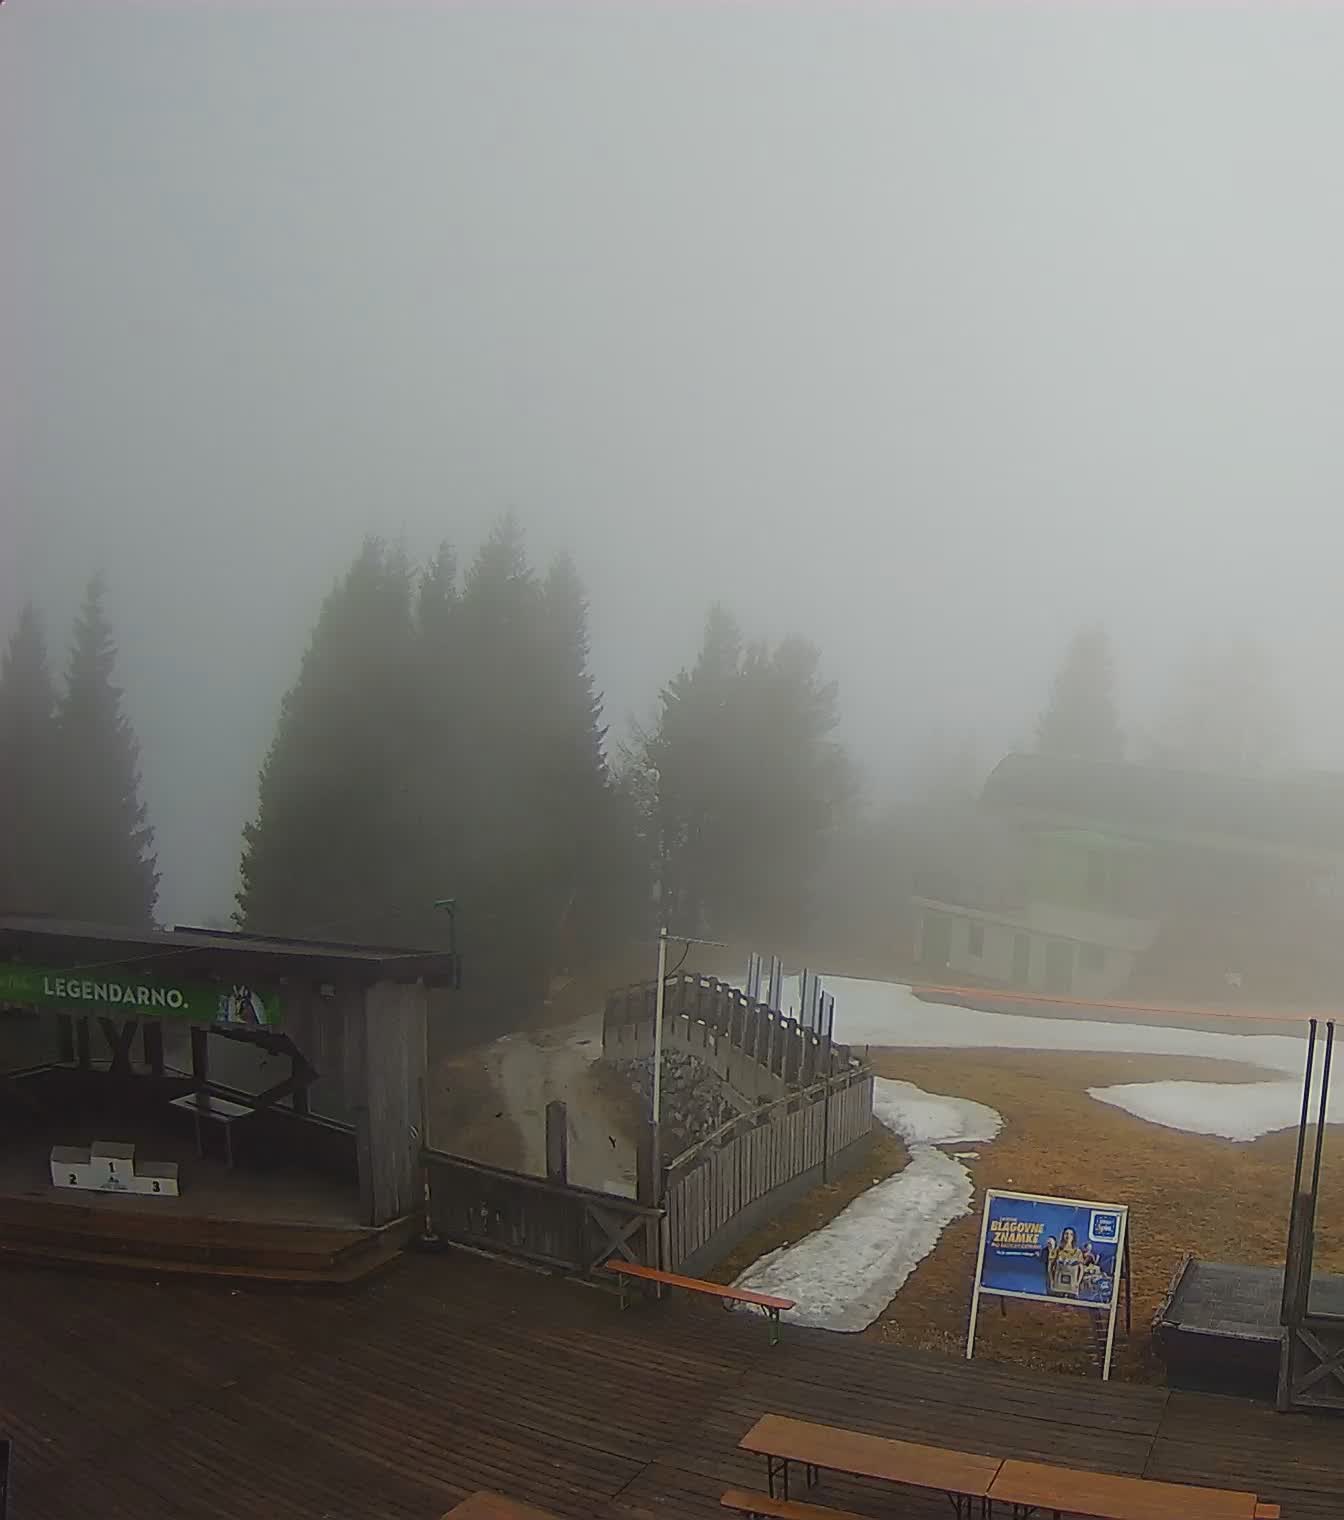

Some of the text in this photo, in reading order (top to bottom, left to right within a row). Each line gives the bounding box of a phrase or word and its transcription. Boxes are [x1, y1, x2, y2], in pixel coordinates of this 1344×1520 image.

[43, 975, 190, 1009] LEGENDARNO.
[108, 1161, 115, 1173] 1
[69, 1174, 78, 1185] 2
[152, 1181, 161, 1192] 3
[990, 1220, 1044, 1233] BLAGOVNE
[993, 1232, 1039, 1243] ZNAMKE
